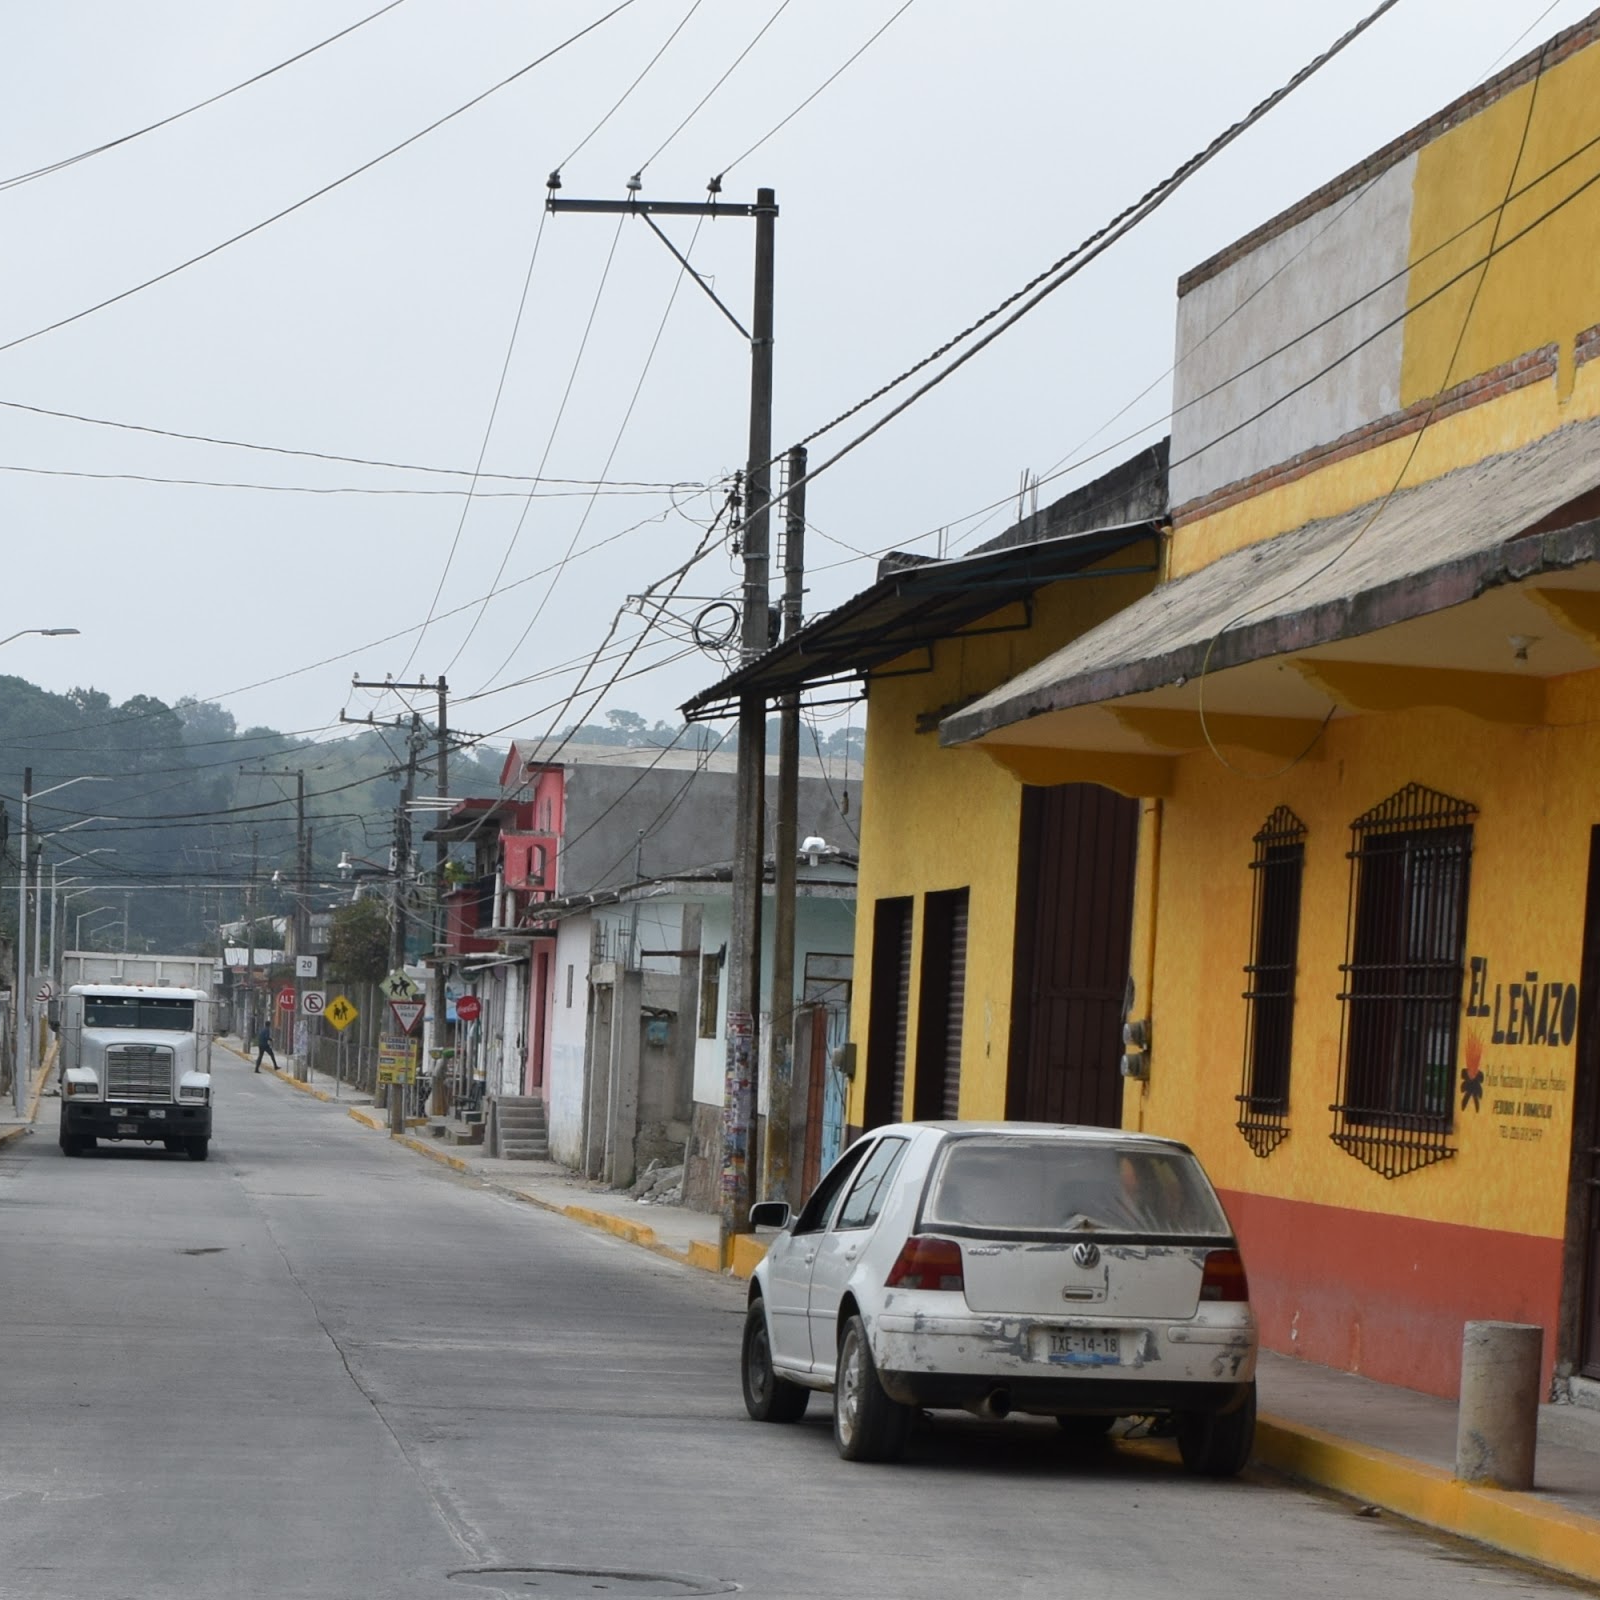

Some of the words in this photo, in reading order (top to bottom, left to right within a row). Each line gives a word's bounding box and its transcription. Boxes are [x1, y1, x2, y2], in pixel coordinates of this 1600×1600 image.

[301, 960, 313, 969] 20
[1466, 955, 1491, 1018] EL
[279, 995, 295, 1005] ALT
[1491, 971, 1578, 1047] LEÑAZO
[1051, 1335, 1118, 1353] TXE-14-18
